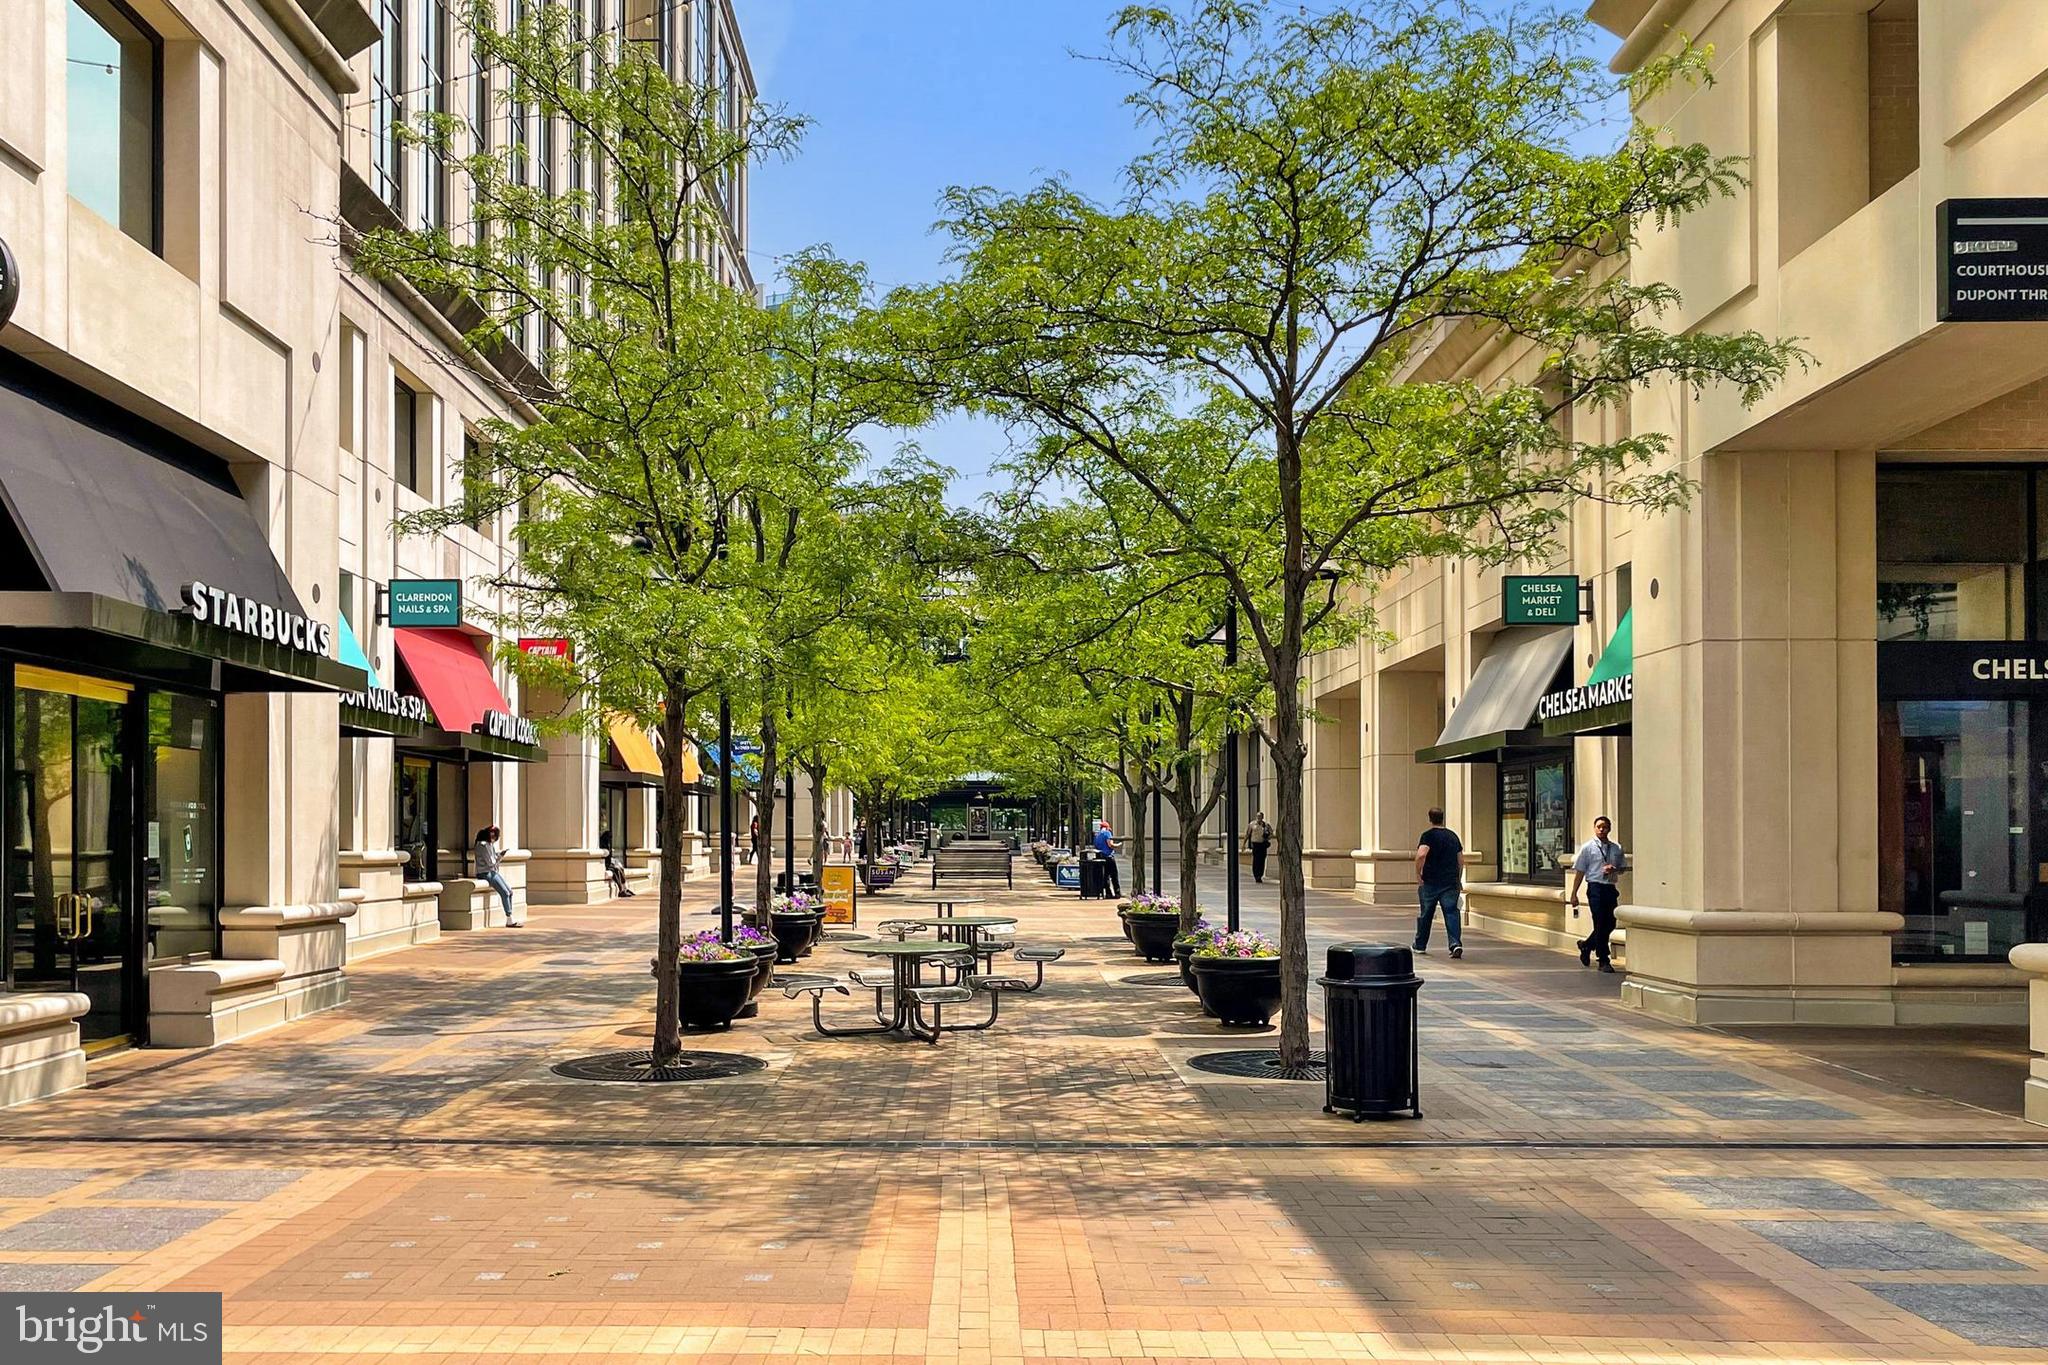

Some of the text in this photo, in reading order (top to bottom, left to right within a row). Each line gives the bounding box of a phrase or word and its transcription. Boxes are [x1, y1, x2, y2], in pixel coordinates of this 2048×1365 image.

[1956, 265, 2048, 277] COURTHOUS
[1956, 289, 2017, 301] DUPONT
[1520, 584, 1563, 593] CHELSEA
[395, 593, 452, 602] CLARENDON
[1522, 596, 1562, 605] MARKET
[398, 605, 450, 614] NAILS & SPA
[1527, 608, 1556, 617] & DELI
[191, 581, 331, 657] STARBUCKS
[1539, 674, 1632, 719] CHELSEA MARKE
[367, 687, 399, 716] NAILS
[400, 698, 408, 717] &
[408, 695, 428, 722] SPA
[489, 709, 516, 742] CAPTAIN
